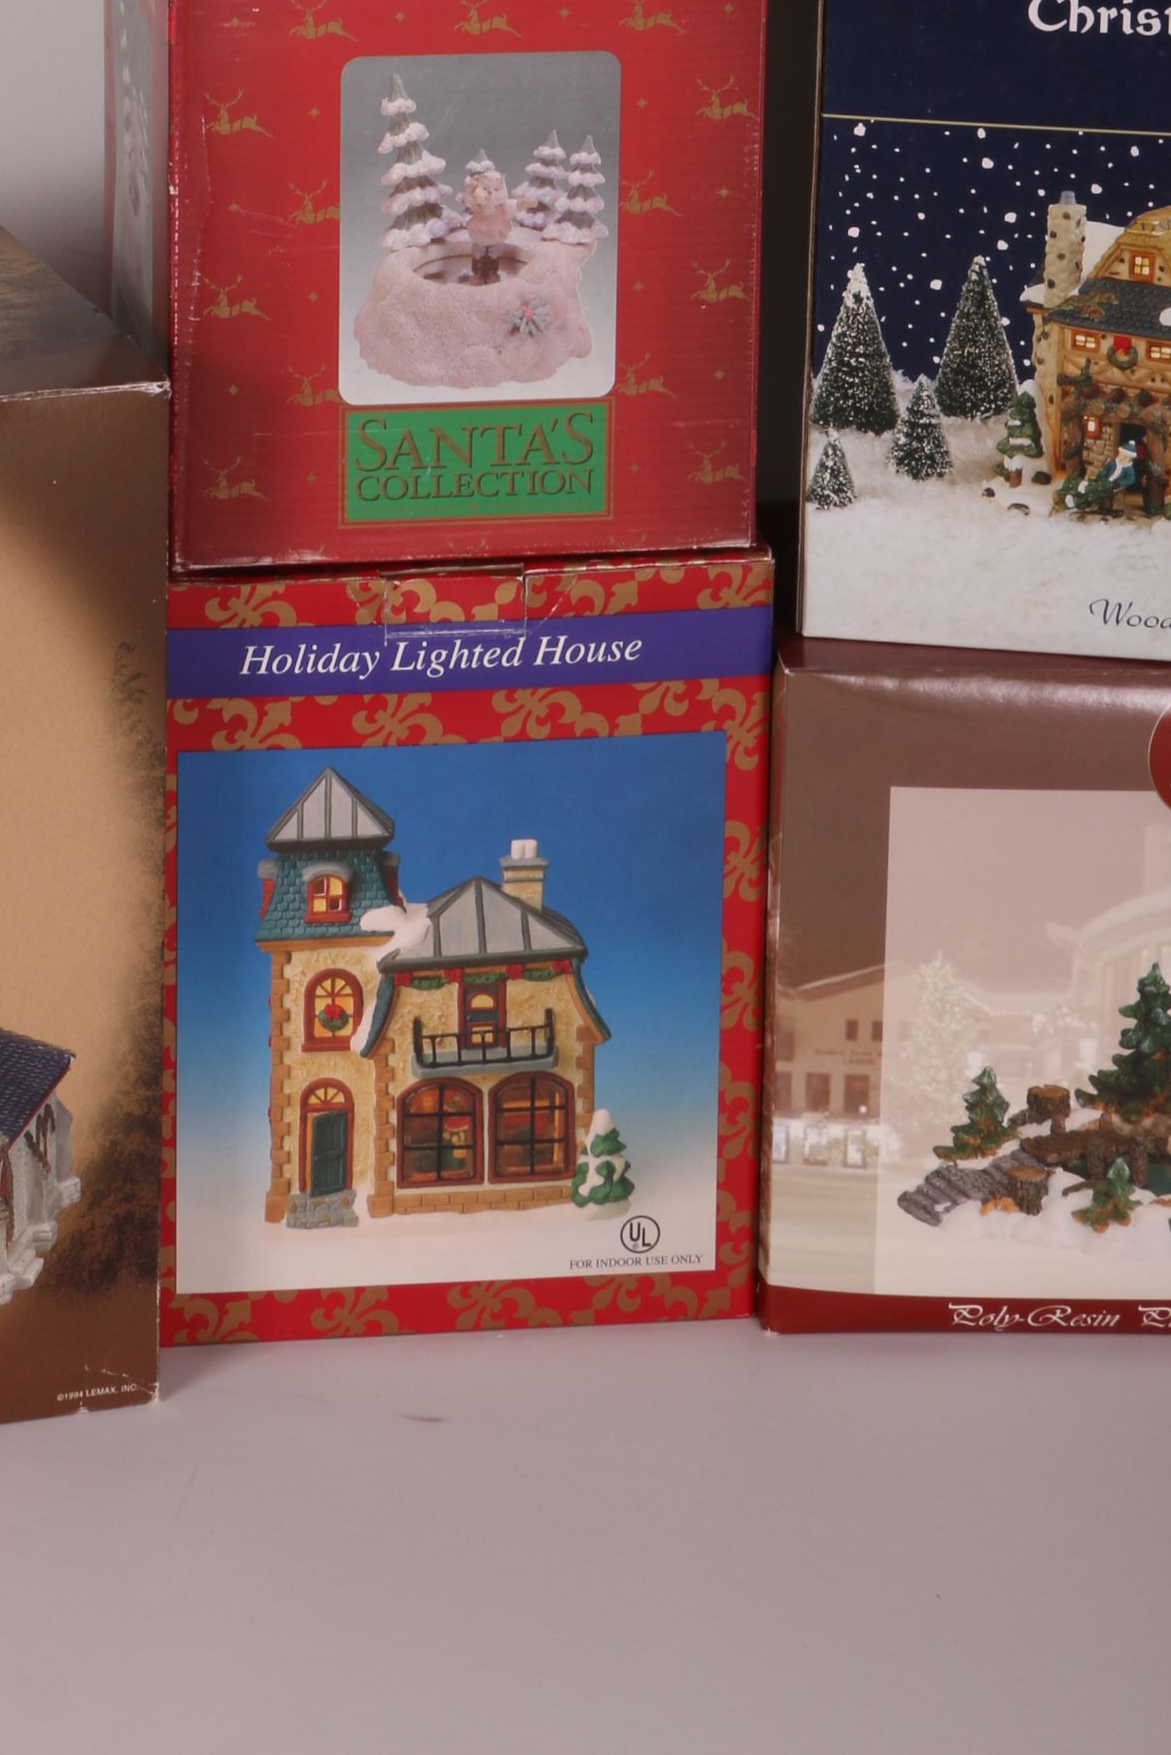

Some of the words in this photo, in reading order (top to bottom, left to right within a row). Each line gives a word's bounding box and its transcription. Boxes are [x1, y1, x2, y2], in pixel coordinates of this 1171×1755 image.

[354, 410, 595, 473] SANTA'S
[353, 468, 595, 502] COLLECTION
[239, 644, 381, 680] Holiday
[390, 636, 526, 678] Lighted
[533, 635, 643, 666] House
[569, 1259, 593, 1270] FOR
[596, 1257, 643, 1268] INDOOR
[645, 1255, 669, 1266] USE
[671, 1254, 703, 1265] ONLY
[948, 1302, 1120, 1331] Poly-Resin
